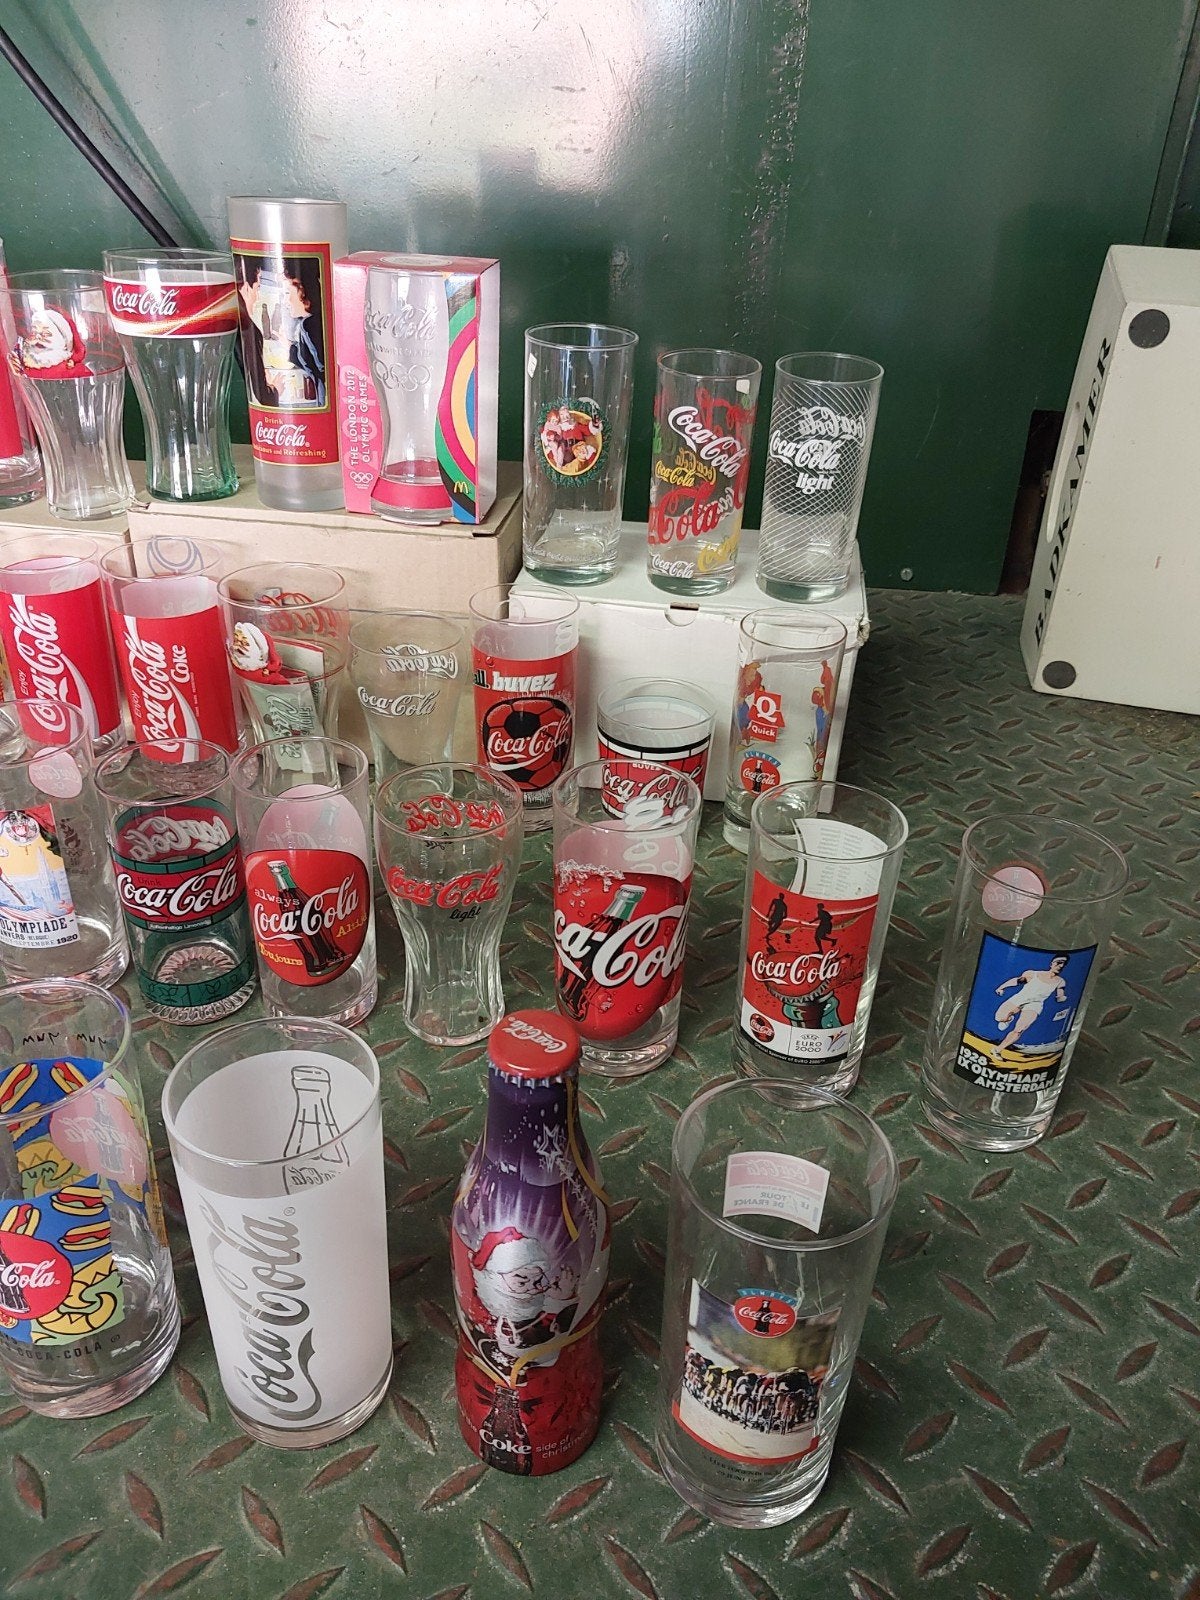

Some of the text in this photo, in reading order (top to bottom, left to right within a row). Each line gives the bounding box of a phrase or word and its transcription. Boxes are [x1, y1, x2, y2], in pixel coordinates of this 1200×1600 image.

[112, 286, 179, 315] Coca-Cola
[264, 416, 283, 425] Drink
[347, 368, 358, 466] THE LONDON 2012
[358, 374, 371, 464] OLYMPIC GAMES
[255, 420, 307, 447] Coca-Cola
[668, 406, 746, 478] Coca-Cola
[283, 449, 327, 458] Refreshing
[770, 429, 845, 470] Coca-Cola
[655, 460, 696, 488] Coca-Cola
[796, 471, 835, 495] light
[651, 553, 694, 579] Coca-Cola
[9, 605, 69, 732] Coca-Cola
[170, 644, 190, 684] Coke
[18, 669, 29, 696] Enjoy
[123, 631, 180, 753] Coca-Cola
[492, 671, 558, 692] buvez
[132, 690, 142, 718] Enjoy
[357, 687, 440, 716] Coca-Cola
[487, 713, 572, 759] Coca-Cola
[751, 725, 776, 737] Quick
[742, 767, 776, 786] Coca-Cola
[117, 854, 238, 917] Coca-Cola
[254, 888, 300, 908] always
[386, 860, 504, 909] Coca-Cola
[254, 872, 360, 941] Coca-Cola
[449, 906, 482, 923] light
[57, 933, 79, 945] 1920
[258, 941, 304, 966] Toujours
[752, 949, 841, 986] Coca-Cola
[501, 1020, 568, 1054] Coca-Cola
[960, 1045, 988, 1066] 1928
[971, 1063, 1049, 1084] OLYMPIADE
[974, 1076, 1055, 1093] AMSTERDAM
[0, 1259, 56, 1288] Cola
[199, 1194, 322, 1422] Coca-Cola
[738, 1306, 791, 1325] Coca-Cola
[17, 1341, 102, 1361] COCA-COLA
[479, 1429, 532, 1454] Coke
[536, 1434, 571, 1453] side of
